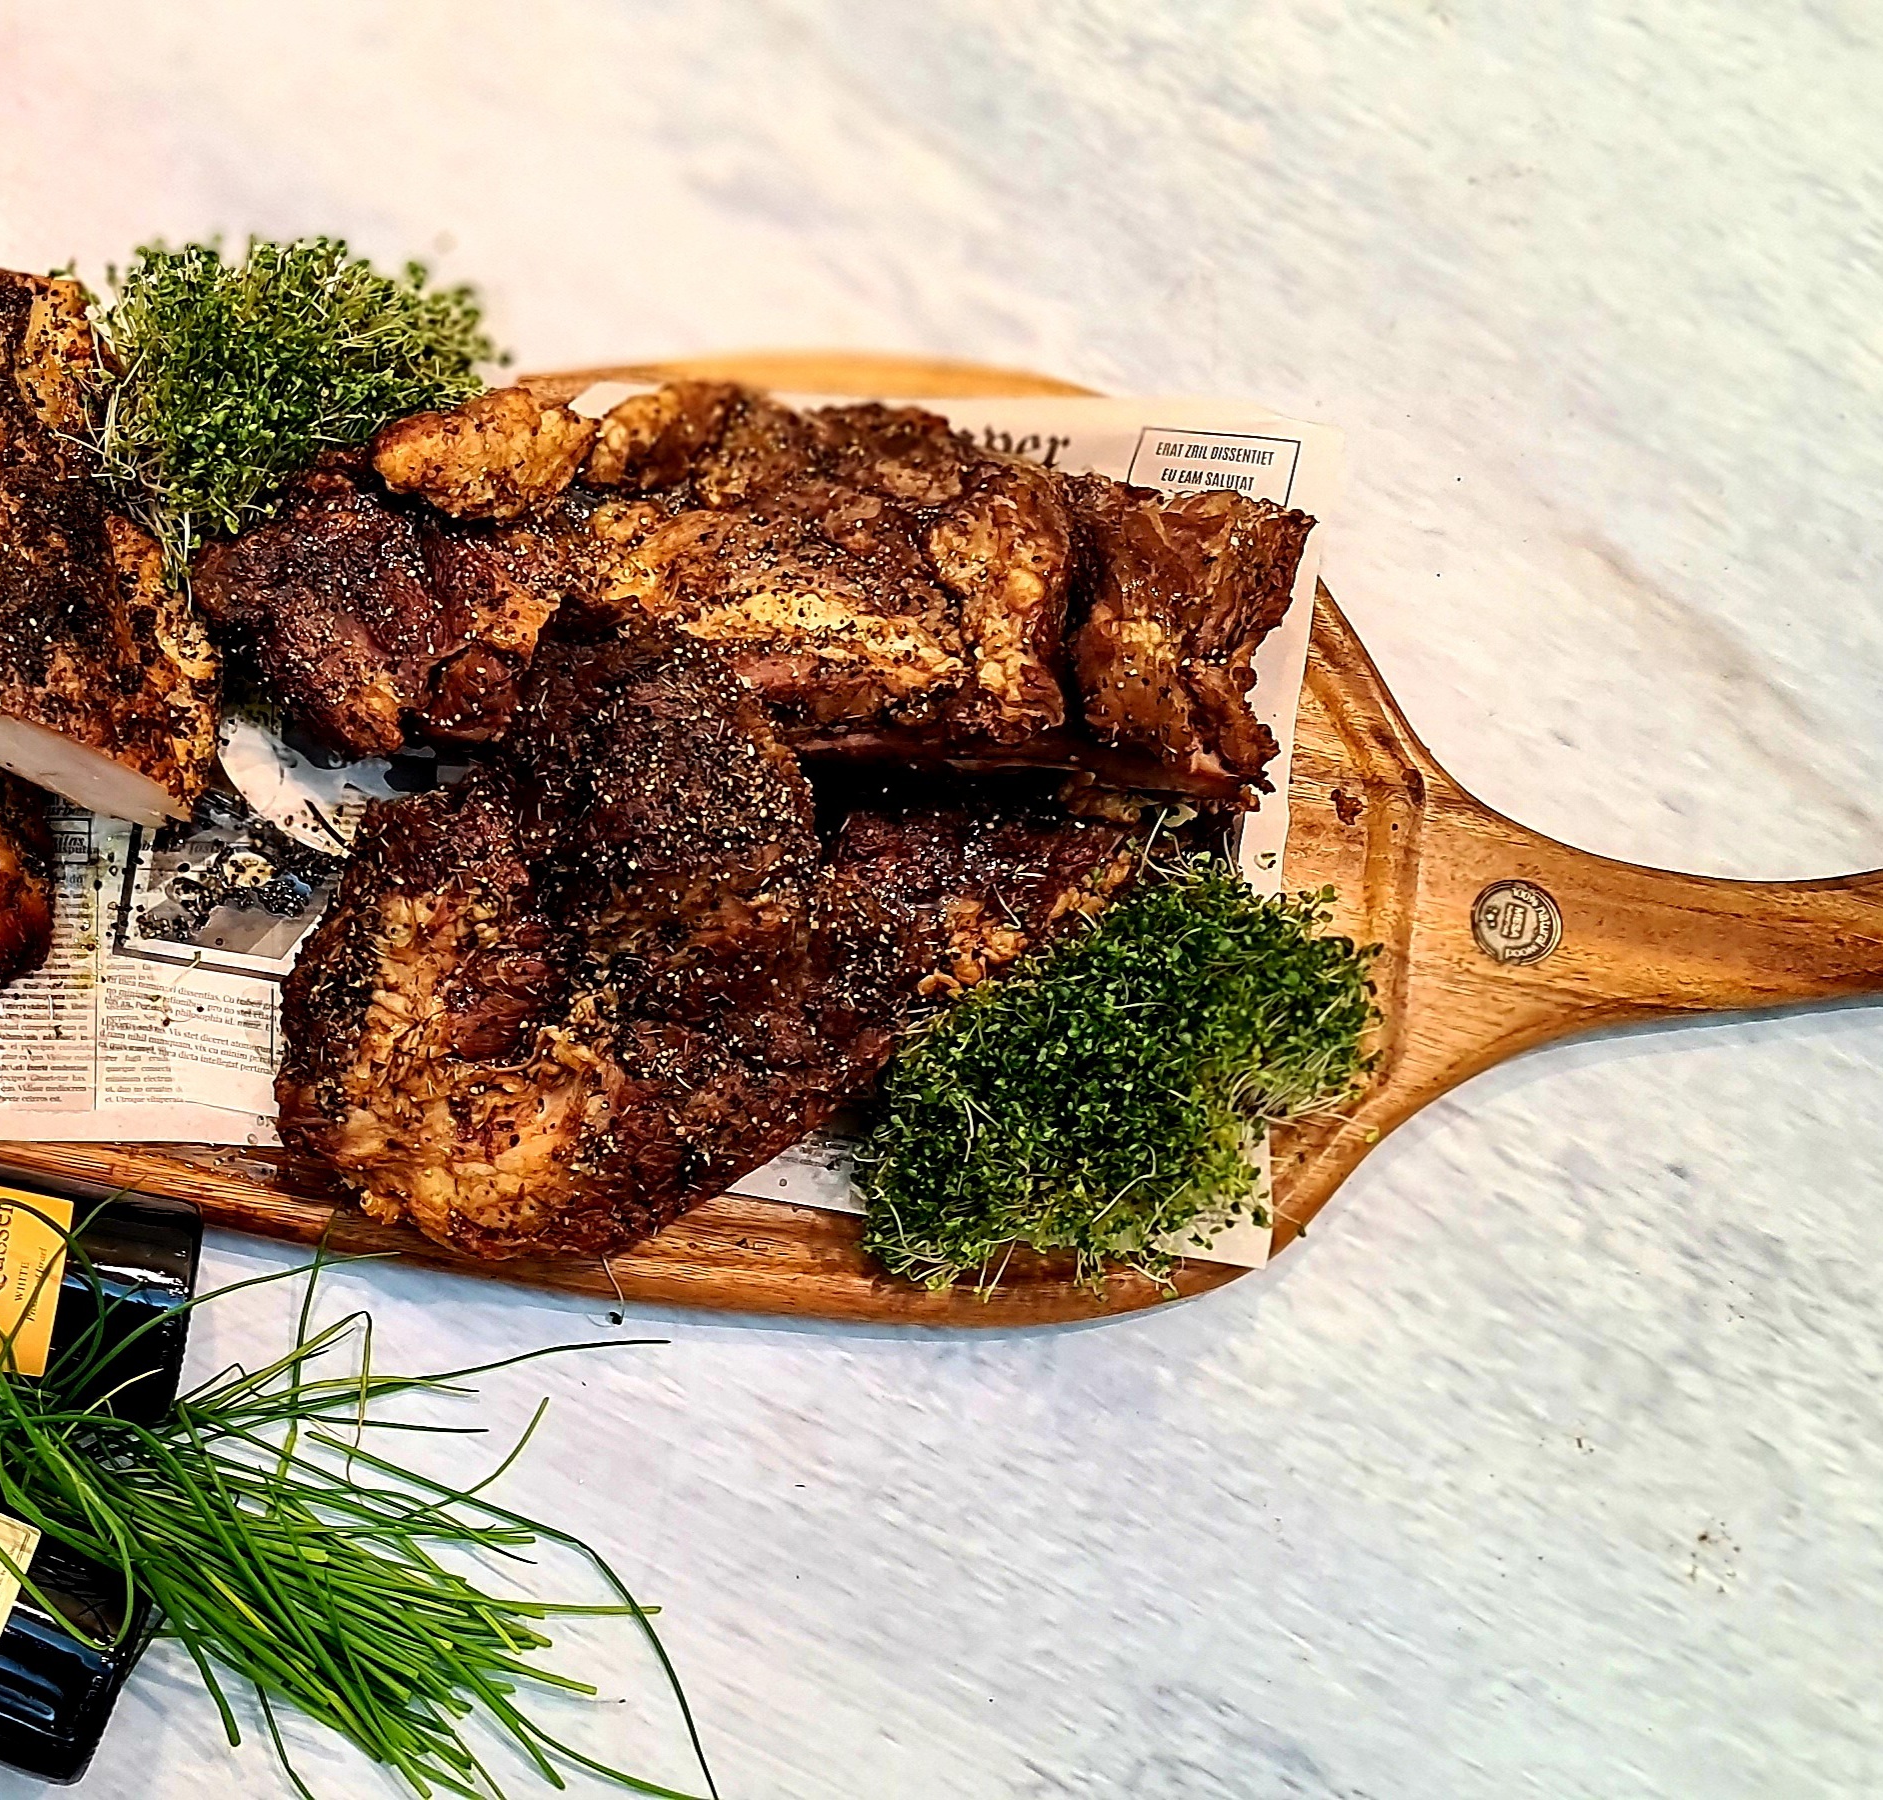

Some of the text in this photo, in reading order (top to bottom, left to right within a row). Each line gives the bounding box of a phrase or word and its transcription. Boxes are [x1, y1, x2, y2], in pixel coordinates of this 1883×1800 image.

[1156, 441, 1275, 466] ERAT ZRIL DISSENTIET
[1161, 468, 1255, 491] EU EAM SALUTAT
[14, 1261, 31, 1302] WHITE
